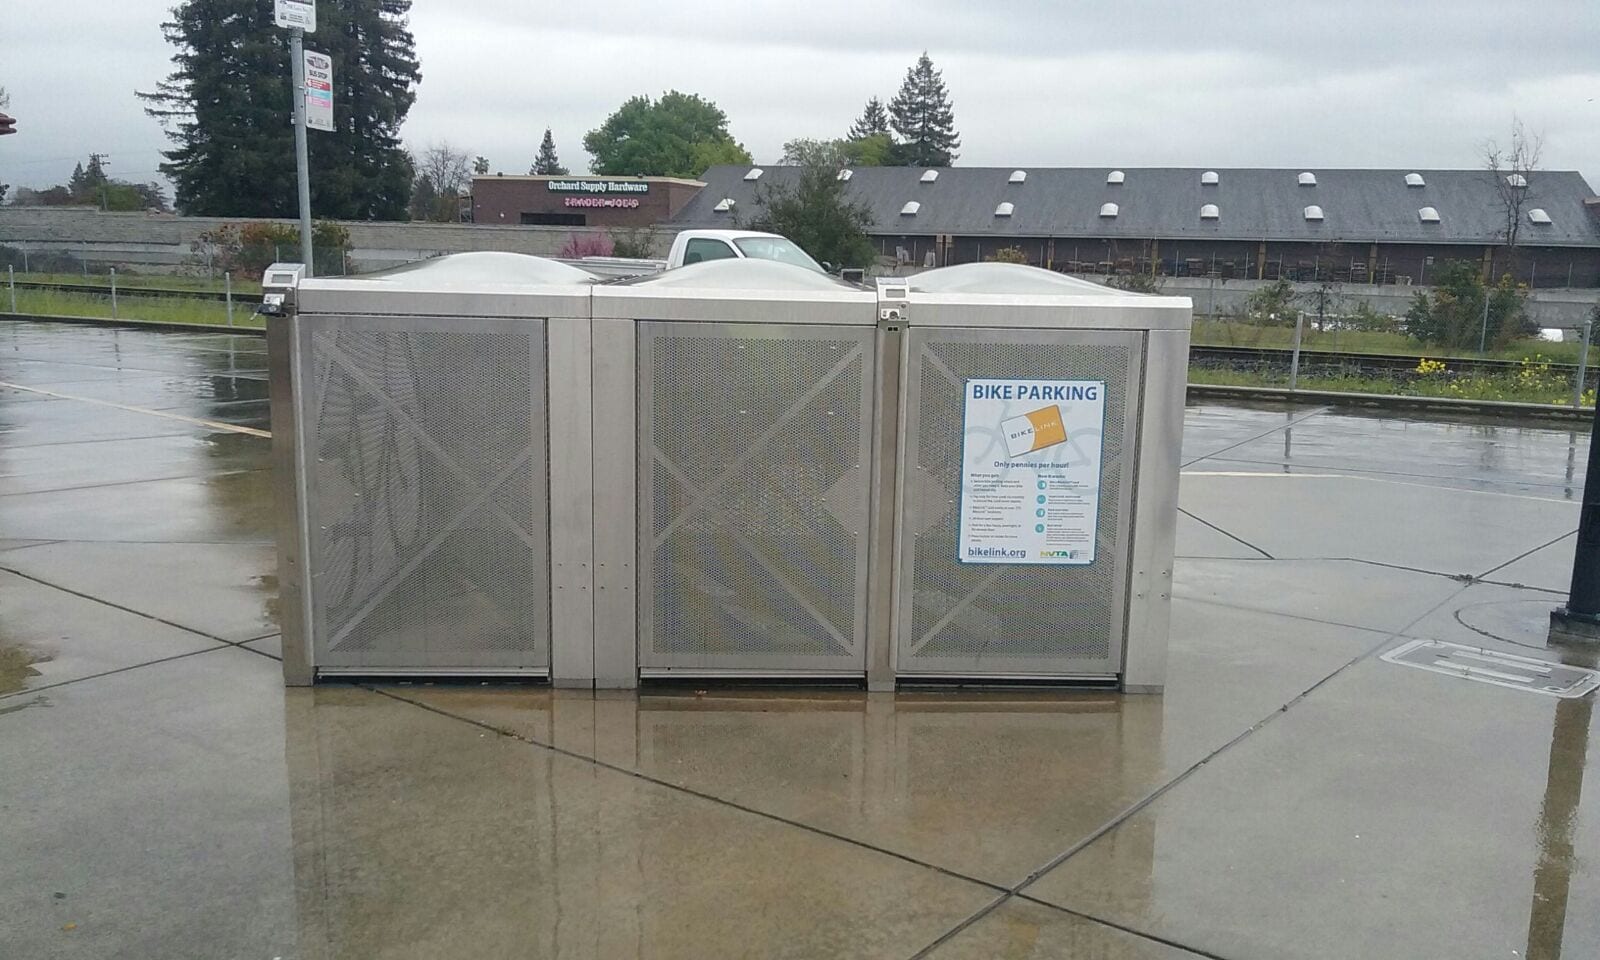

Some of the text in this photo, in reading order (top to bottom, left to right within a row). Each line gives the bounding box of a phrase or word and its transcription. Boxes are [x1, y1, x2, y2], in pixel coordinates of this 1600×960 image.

[548, 181, 648, 192] Orchard Supply Hardware
[973, 385, 1097, 400] BIKE PARKING
[968, 546, 1026, 558] bikelink.org
